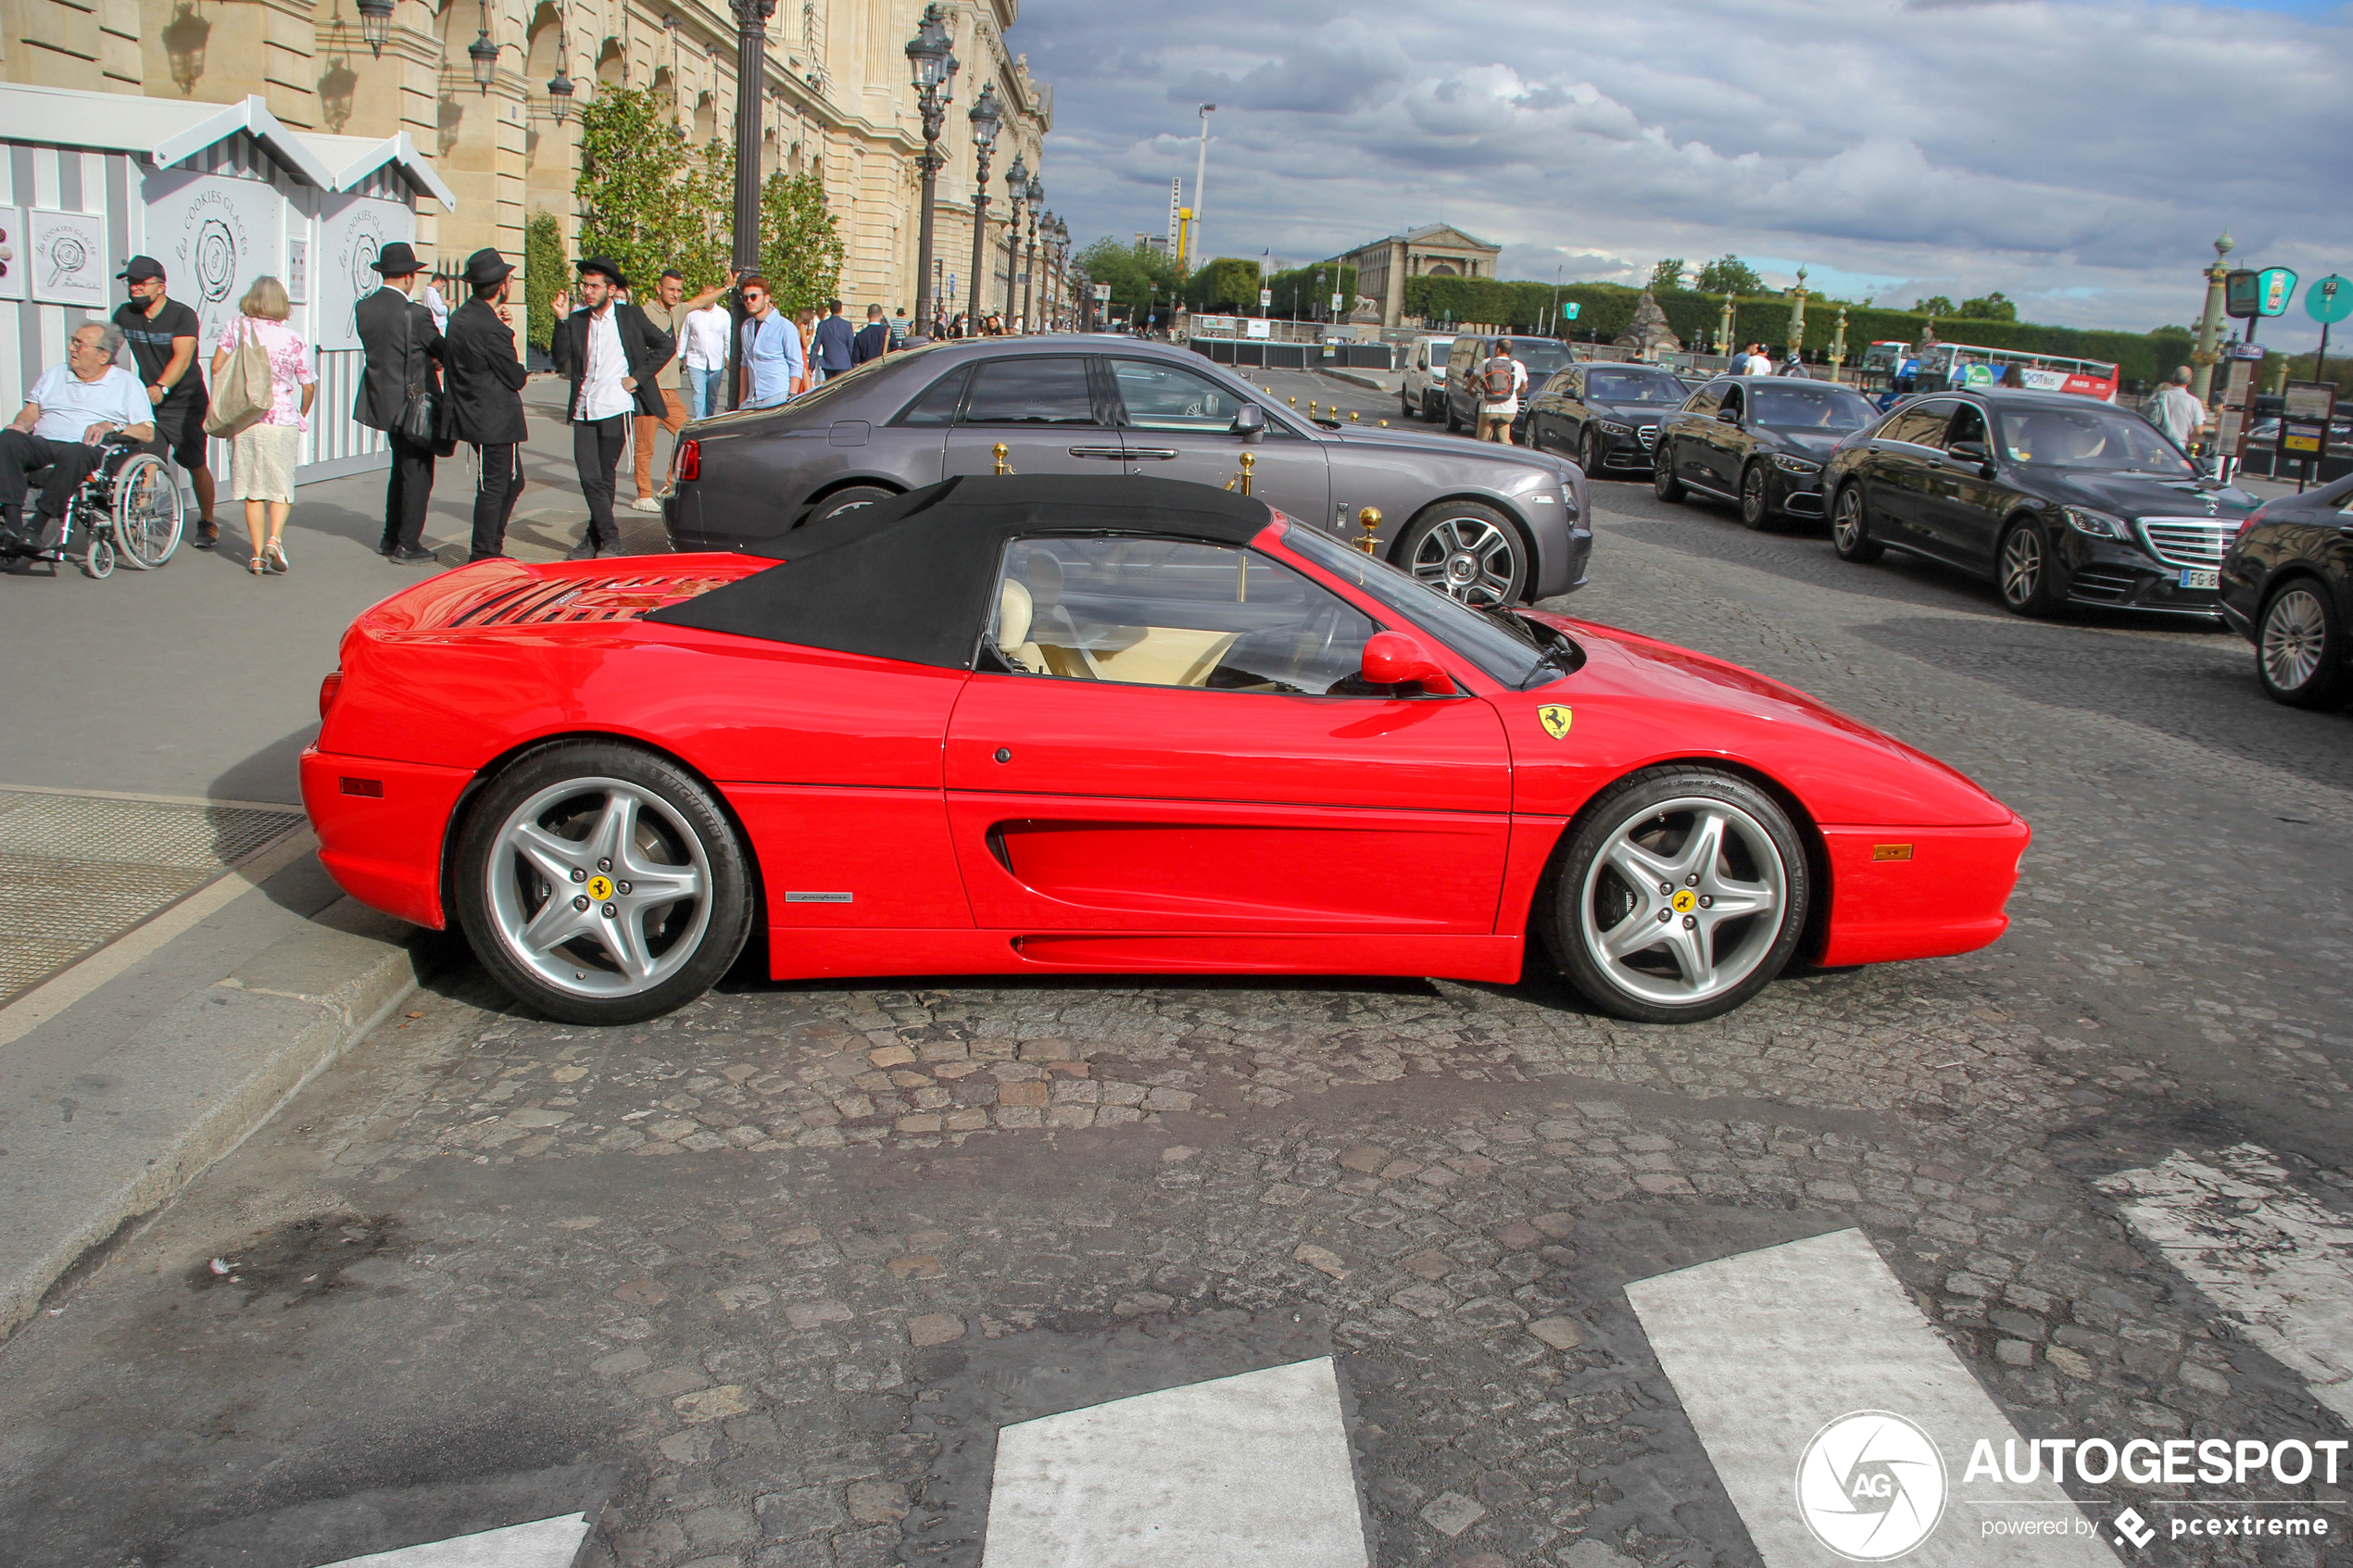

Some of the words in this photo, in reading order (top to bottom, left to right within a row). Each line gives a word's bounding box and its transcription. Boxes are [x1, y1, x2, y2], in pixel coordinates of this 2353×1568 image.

[184, 190, 222, 230] COOKIES
[43, 225, 73, 242] COOKIES
[346, 209, 372, 243] COOKIES
[2070, 379, 2091, 388] PARIS
[2190, 572, 2220, 586] FG-8
[1707, 780, 1736, 792] Sport
[660, 773, 723, 837] MICHELIN
